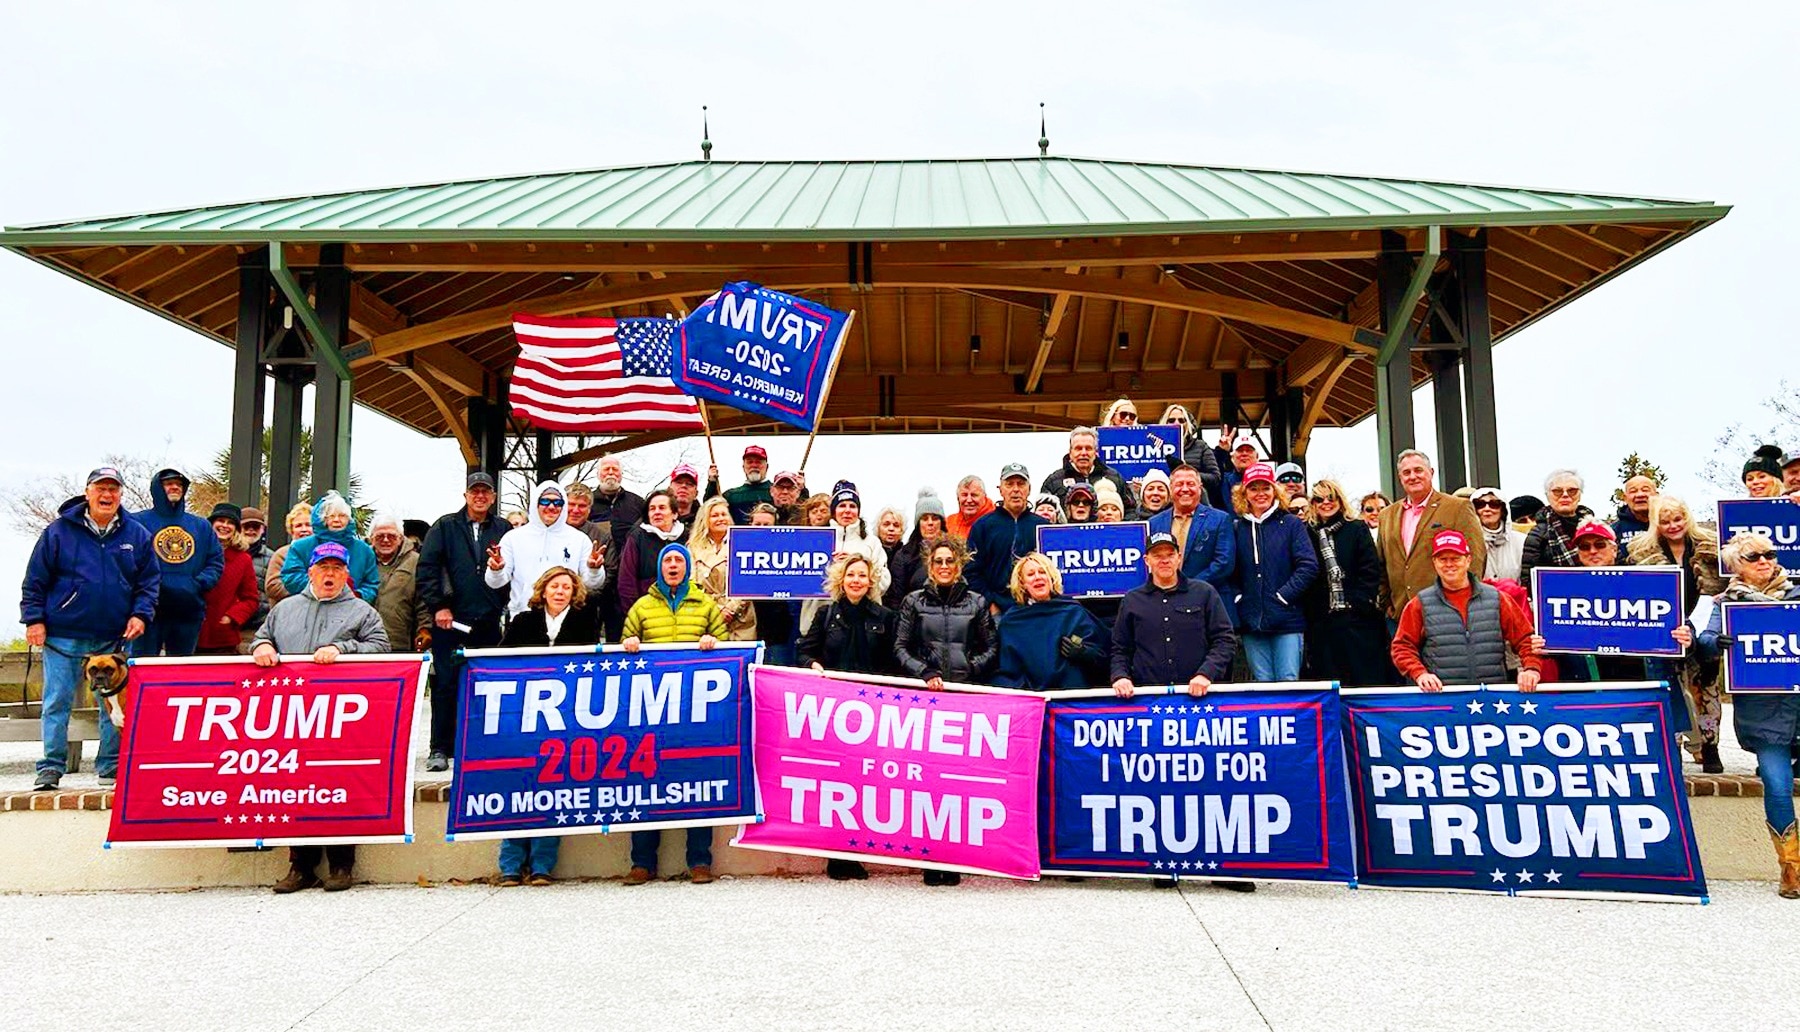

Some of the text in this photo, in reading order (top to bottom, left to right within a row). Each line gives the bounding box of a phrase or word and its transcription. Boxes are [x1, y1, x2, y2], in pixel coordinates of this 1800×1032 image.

[1101, 444, 1176, 460] TRUMP
[1729, 525, 1798, 544] TRU
[736, 551, 829, 570] TRUMP
[1046, 547, 1141, 568] TRUMP
[1547, 597, 1672, 620] TRUMP
[1610, 620, 1637, 628] GREAT
[1597, 645, 1621, 654] 2024
[1738, 634, 1800, 656] TRU
[1769, 656, 1800, 664] AMERIC
[474, 668, 732, 735] TRUMP
[166, 693, 369, 742] TRUMP
[784, 691, 1011, 760] WOMEN
[1073, 716, 1297, 748] DON'T BLAME ME
[1365, 722, 1654, 760] I SUPPORT
[216, 748, 300, 775] 2024
[537, 732, 658, 783] 2024
[861, 758, 923, 782] FOR
[1102, 752, 1267, 783] I VOTED FOR
[1370, 763, 1660, 798] PRESIDENT
[162, 784, 348, 807] Save America
[466, 780, 729, 816] NO MORE BULLSHIT
[781, 775, 1007, 847] TRUMP
[1081, 793, 1292, 854] TRUMP
[1375, 803, 1671, 860] TRUMP
